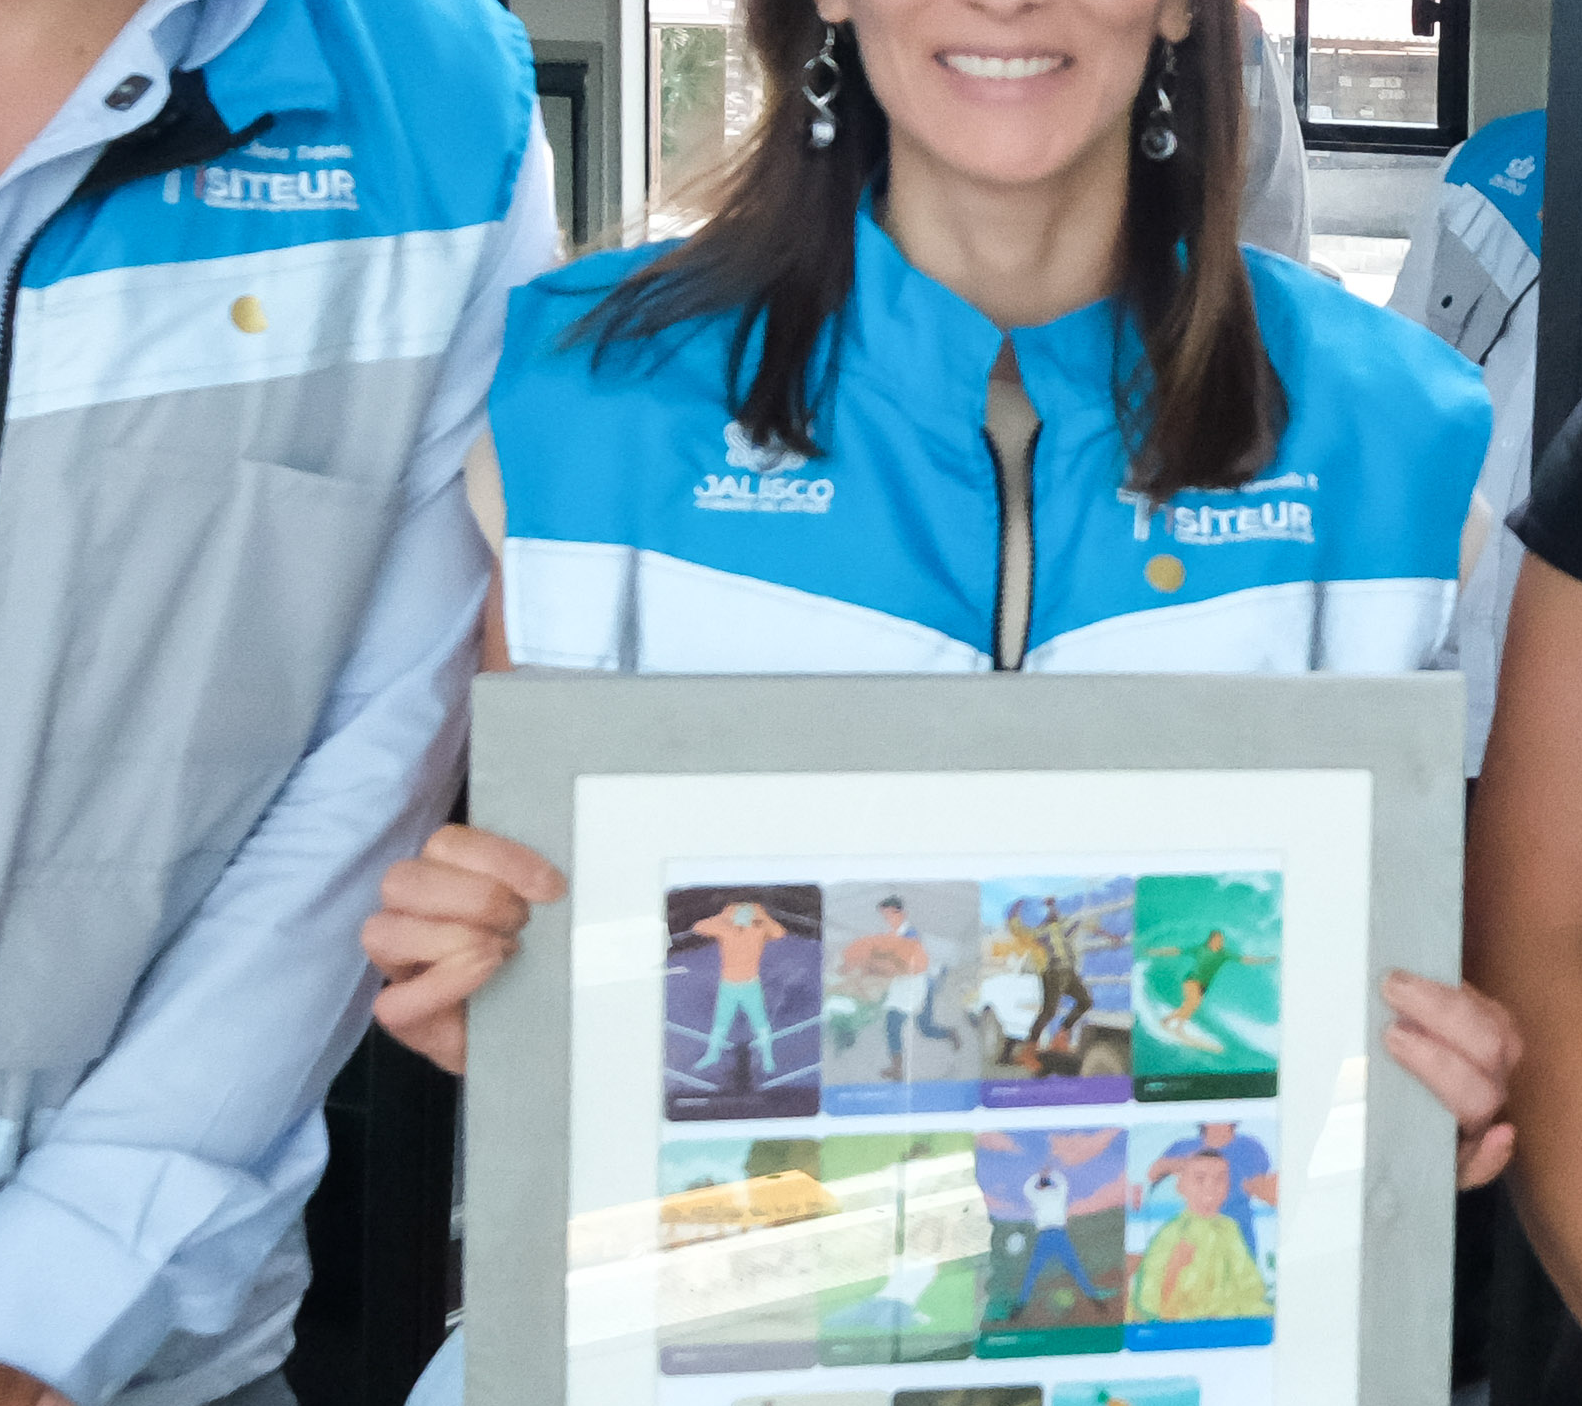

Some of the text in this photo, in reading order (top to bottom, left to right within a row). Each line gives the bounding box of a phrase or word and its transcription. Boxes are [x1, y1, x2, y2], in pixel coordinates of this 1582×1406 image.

[203, 166, 357, 202] SITEUR
[693, 474, 835, 499] JALISCO
[1173, 501, 1313, 534] SITEUR
